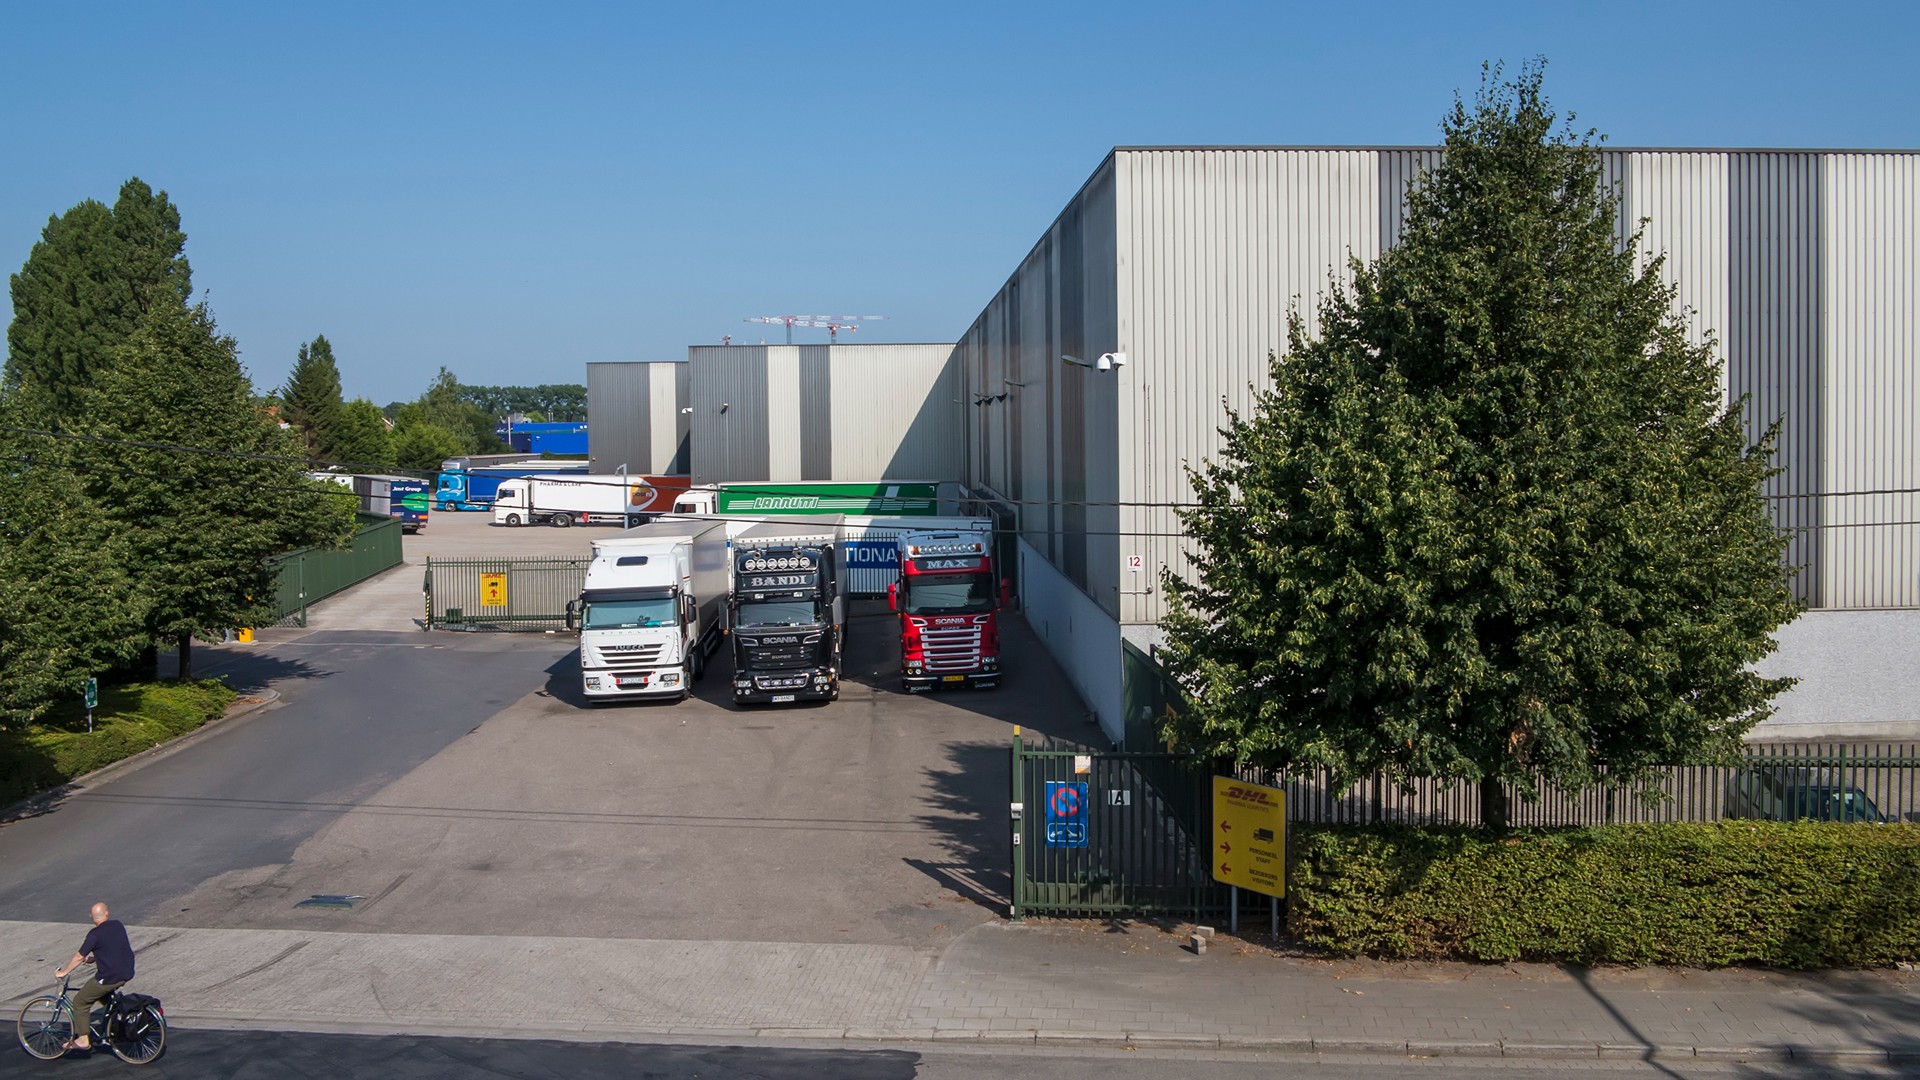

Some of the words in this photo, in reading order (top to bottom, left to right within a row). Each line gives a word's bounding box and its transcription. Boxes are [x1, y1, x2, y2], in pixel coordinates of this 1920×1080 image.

[753, 496, 819, 509] LANNUTTI
[926, 559, 969, 569] MAX
[1129, 556, 1141, 567] 12
[750, 575, 807, 587] BANDI
[935, 617, 966, 625] SCANIA
[762, 636, 799, 644] SCANIA
[1114, 791, 1125, 805] A
[1228, 786, 1270, 805] DHL
[1249, 847, 1278, 860] PERSONEEL
[1256, 857, 1271, 865] STAFF
[1252, 877, 1275, 888] VISITORS
